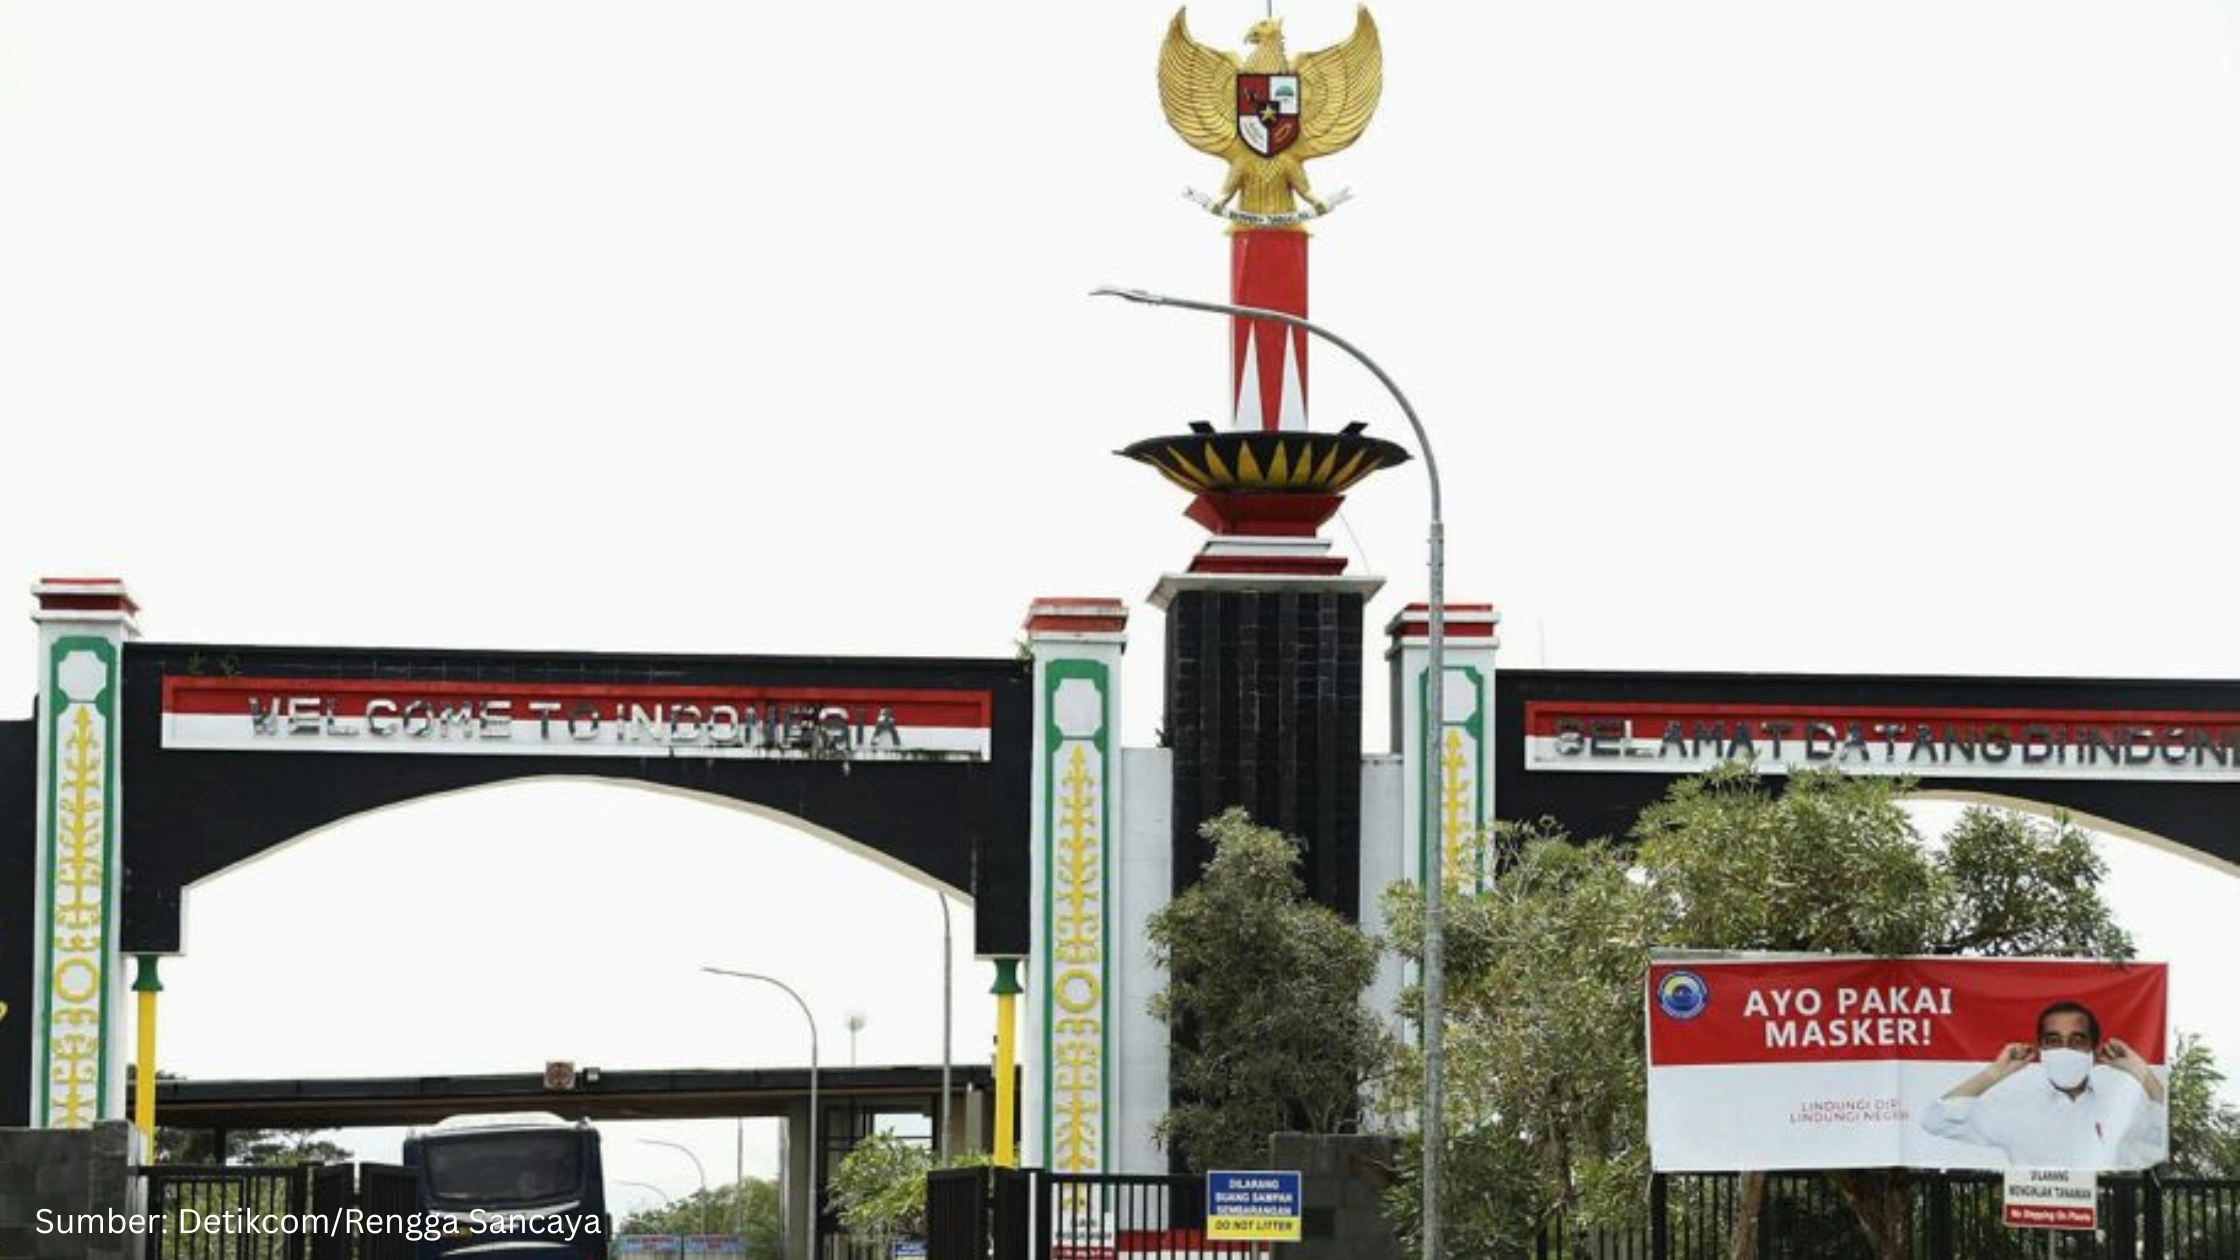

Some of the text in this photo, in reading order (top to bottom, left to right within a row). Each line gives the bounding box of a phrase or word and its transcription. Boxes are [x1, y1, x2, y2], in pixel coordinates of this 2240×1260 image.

[249, 697, 900, 747] WELCOME TO INDONESIA
[1553, 720, 1792, 760] SELAMAT
[1804, 721, 2012, 764] DATANG
[2074, 726, 2240, 767] INDON
[1743, 986, 1953, 1017] AYO PAKAI
[1764, 1018, 1932, 1049] MASKER!
[1801, 1099, 1870, 1113] LINDUNGI
[1789, 1111, 1860, 1124] LINDUNGI
[1229, 1179, 1279, 1190] DILARANG
[1215, 1191, 1250, 1203] BUANG
[1215, 1219, 1292, 1231] DO NOT LITTER
